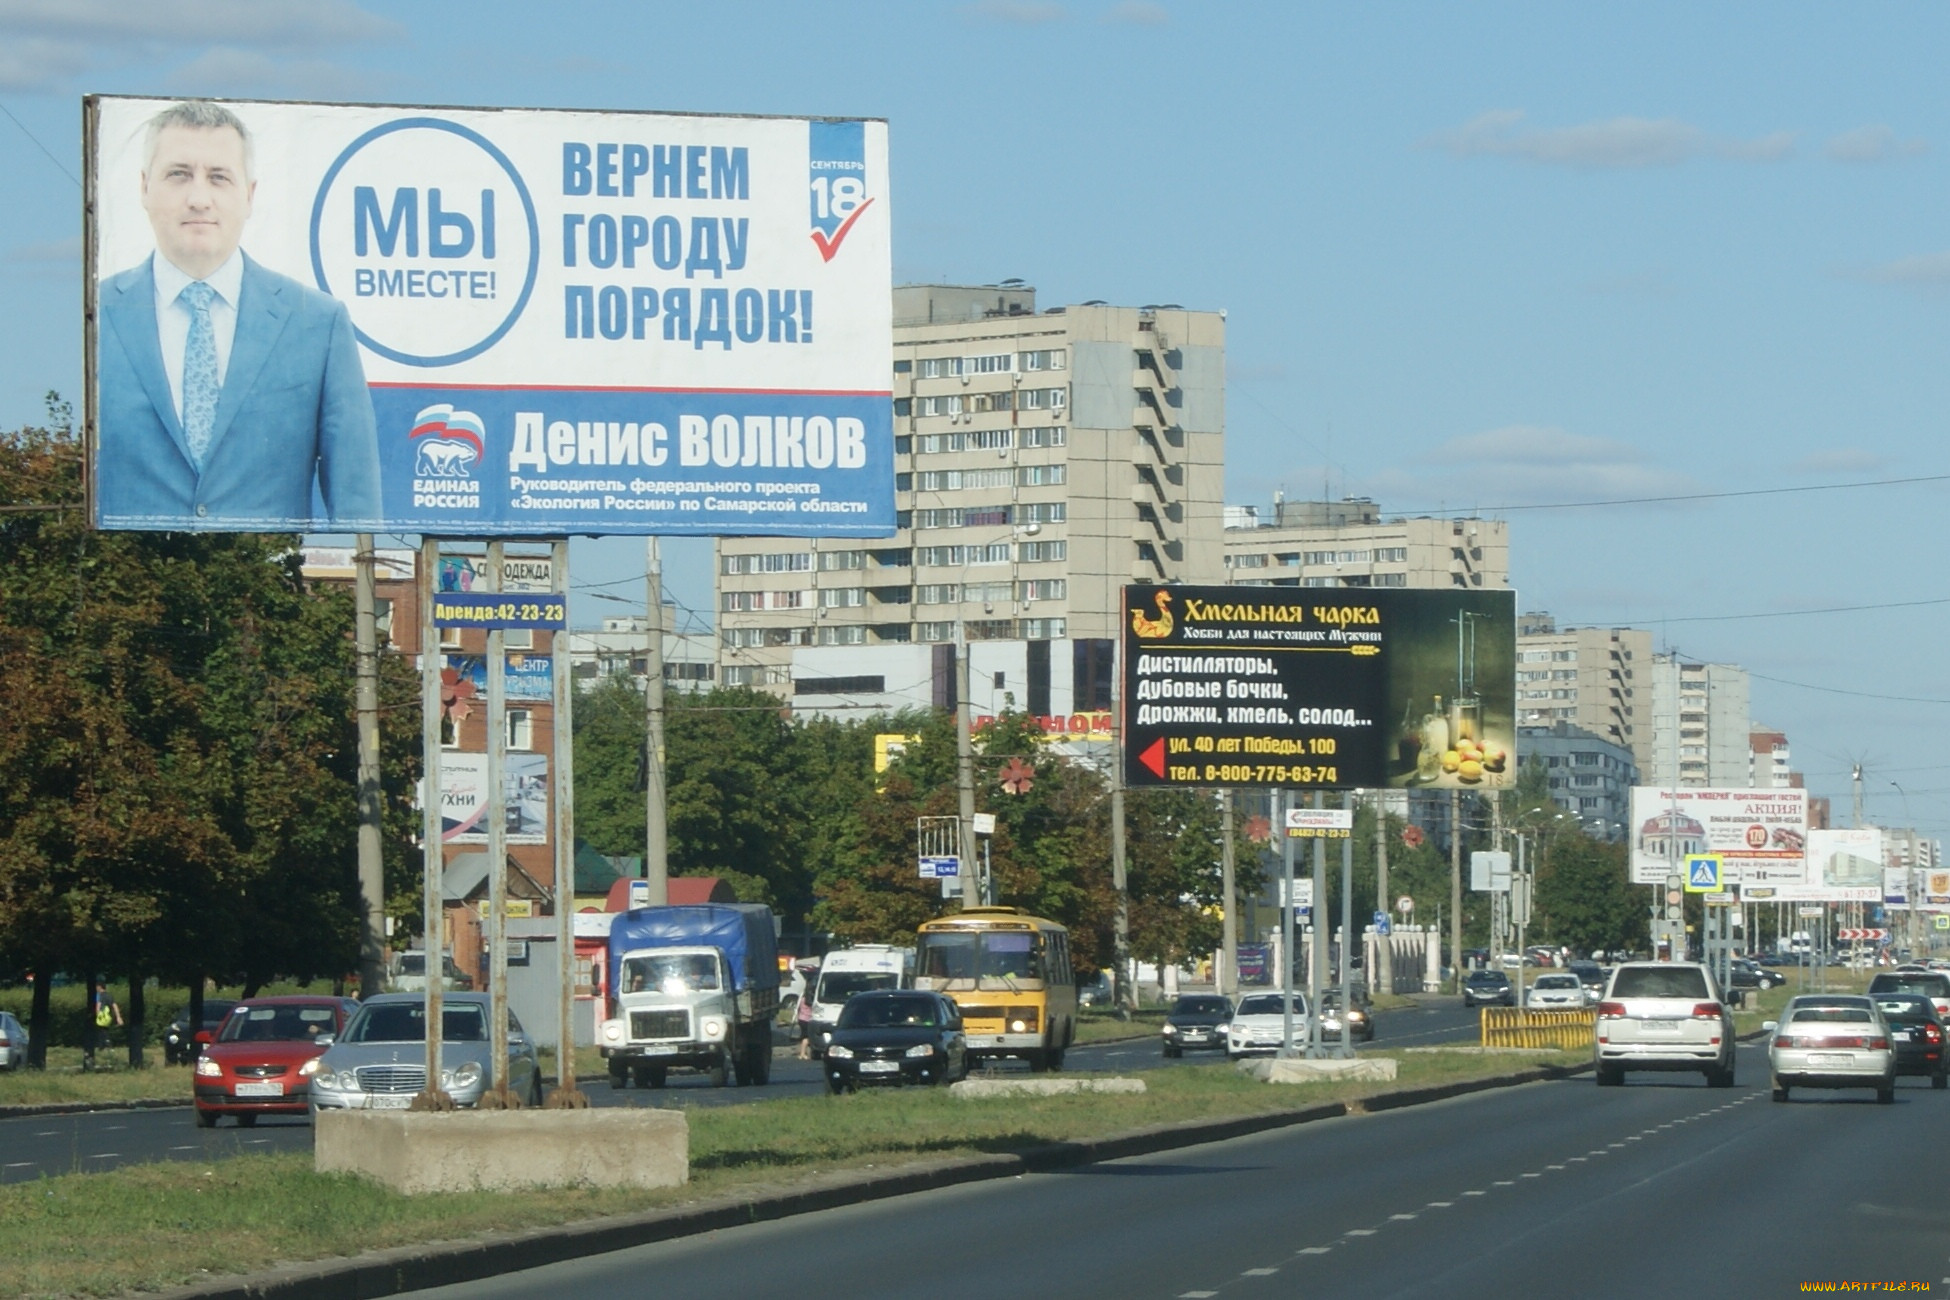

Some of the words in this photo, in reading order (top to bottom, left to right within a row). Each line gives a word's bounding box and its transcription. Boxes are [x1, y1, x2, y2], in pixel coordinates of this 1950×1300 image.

[562, 142, 750, 200] ВЕРНЕМ
[810, 160, 865, 171] СЕНТЯБРЬ
[810, 176, 864, 219] 18
[354, 186, 496, 259] МЫ
[562, 213, 750, 279] ГОРОДУ
[355, 268, 496, 299] ВМЕСТЕ!
[564, 285, 813, 351] ПОРЯДОК!
[509, 412, 669, 473] Денис
[679, 414, 866, 469] ВОЛКОВ
[413, 479, 480, 494] ЕДИНАЯ
[510, 476, 626, 493] Руководитель
[630, 477, 752, 496] федерального
[756, 482, 820, 496] проекта
[414, 494, 480, 508] РОССИЯ
[511, 495, 600, 510] «Экология
[604, 496, 675, 511] России»
[680, 499, 700, 511] по
[704, 496, 796, 514] Самарской
[800, 499, 868, 513] области
[436, 603, 564, 621] Аренда:42-23-23
[1184, 599, 1303, 623] Хмельная
[1312, 606, 1380, 630] чарка
[1183, 626, 1223, 640] Хобби
[1226, 630, 1250, 640] для
[1254, 630, 1326, 642] настоящих
[1328, 629, 1382, 645] Мужчин
[1137, 654, 1278, 676] Дистилляторы,
[1136, 679, 1222, 700] Дубовые
[1226, 679, 1288, 700] бочки,
[1136, 704, 1223, 725] Дрожжи,
[1300, 708, 1372, 726] солод...
[1169, 738, 1192, 754] ул.
[1194, 736, 1214, 753] 40
[1216, 738, 1242, 753] лет
[1244, 736, 1305, 755] Победы,
[1309, 738, 1336, 755] 100
[1169, 766, 1201, 781] тел.
[1205, 766, 1338, 783] 8-800-775-63-74
[1744, 804, 1802, 816] АКЦИЯ!
